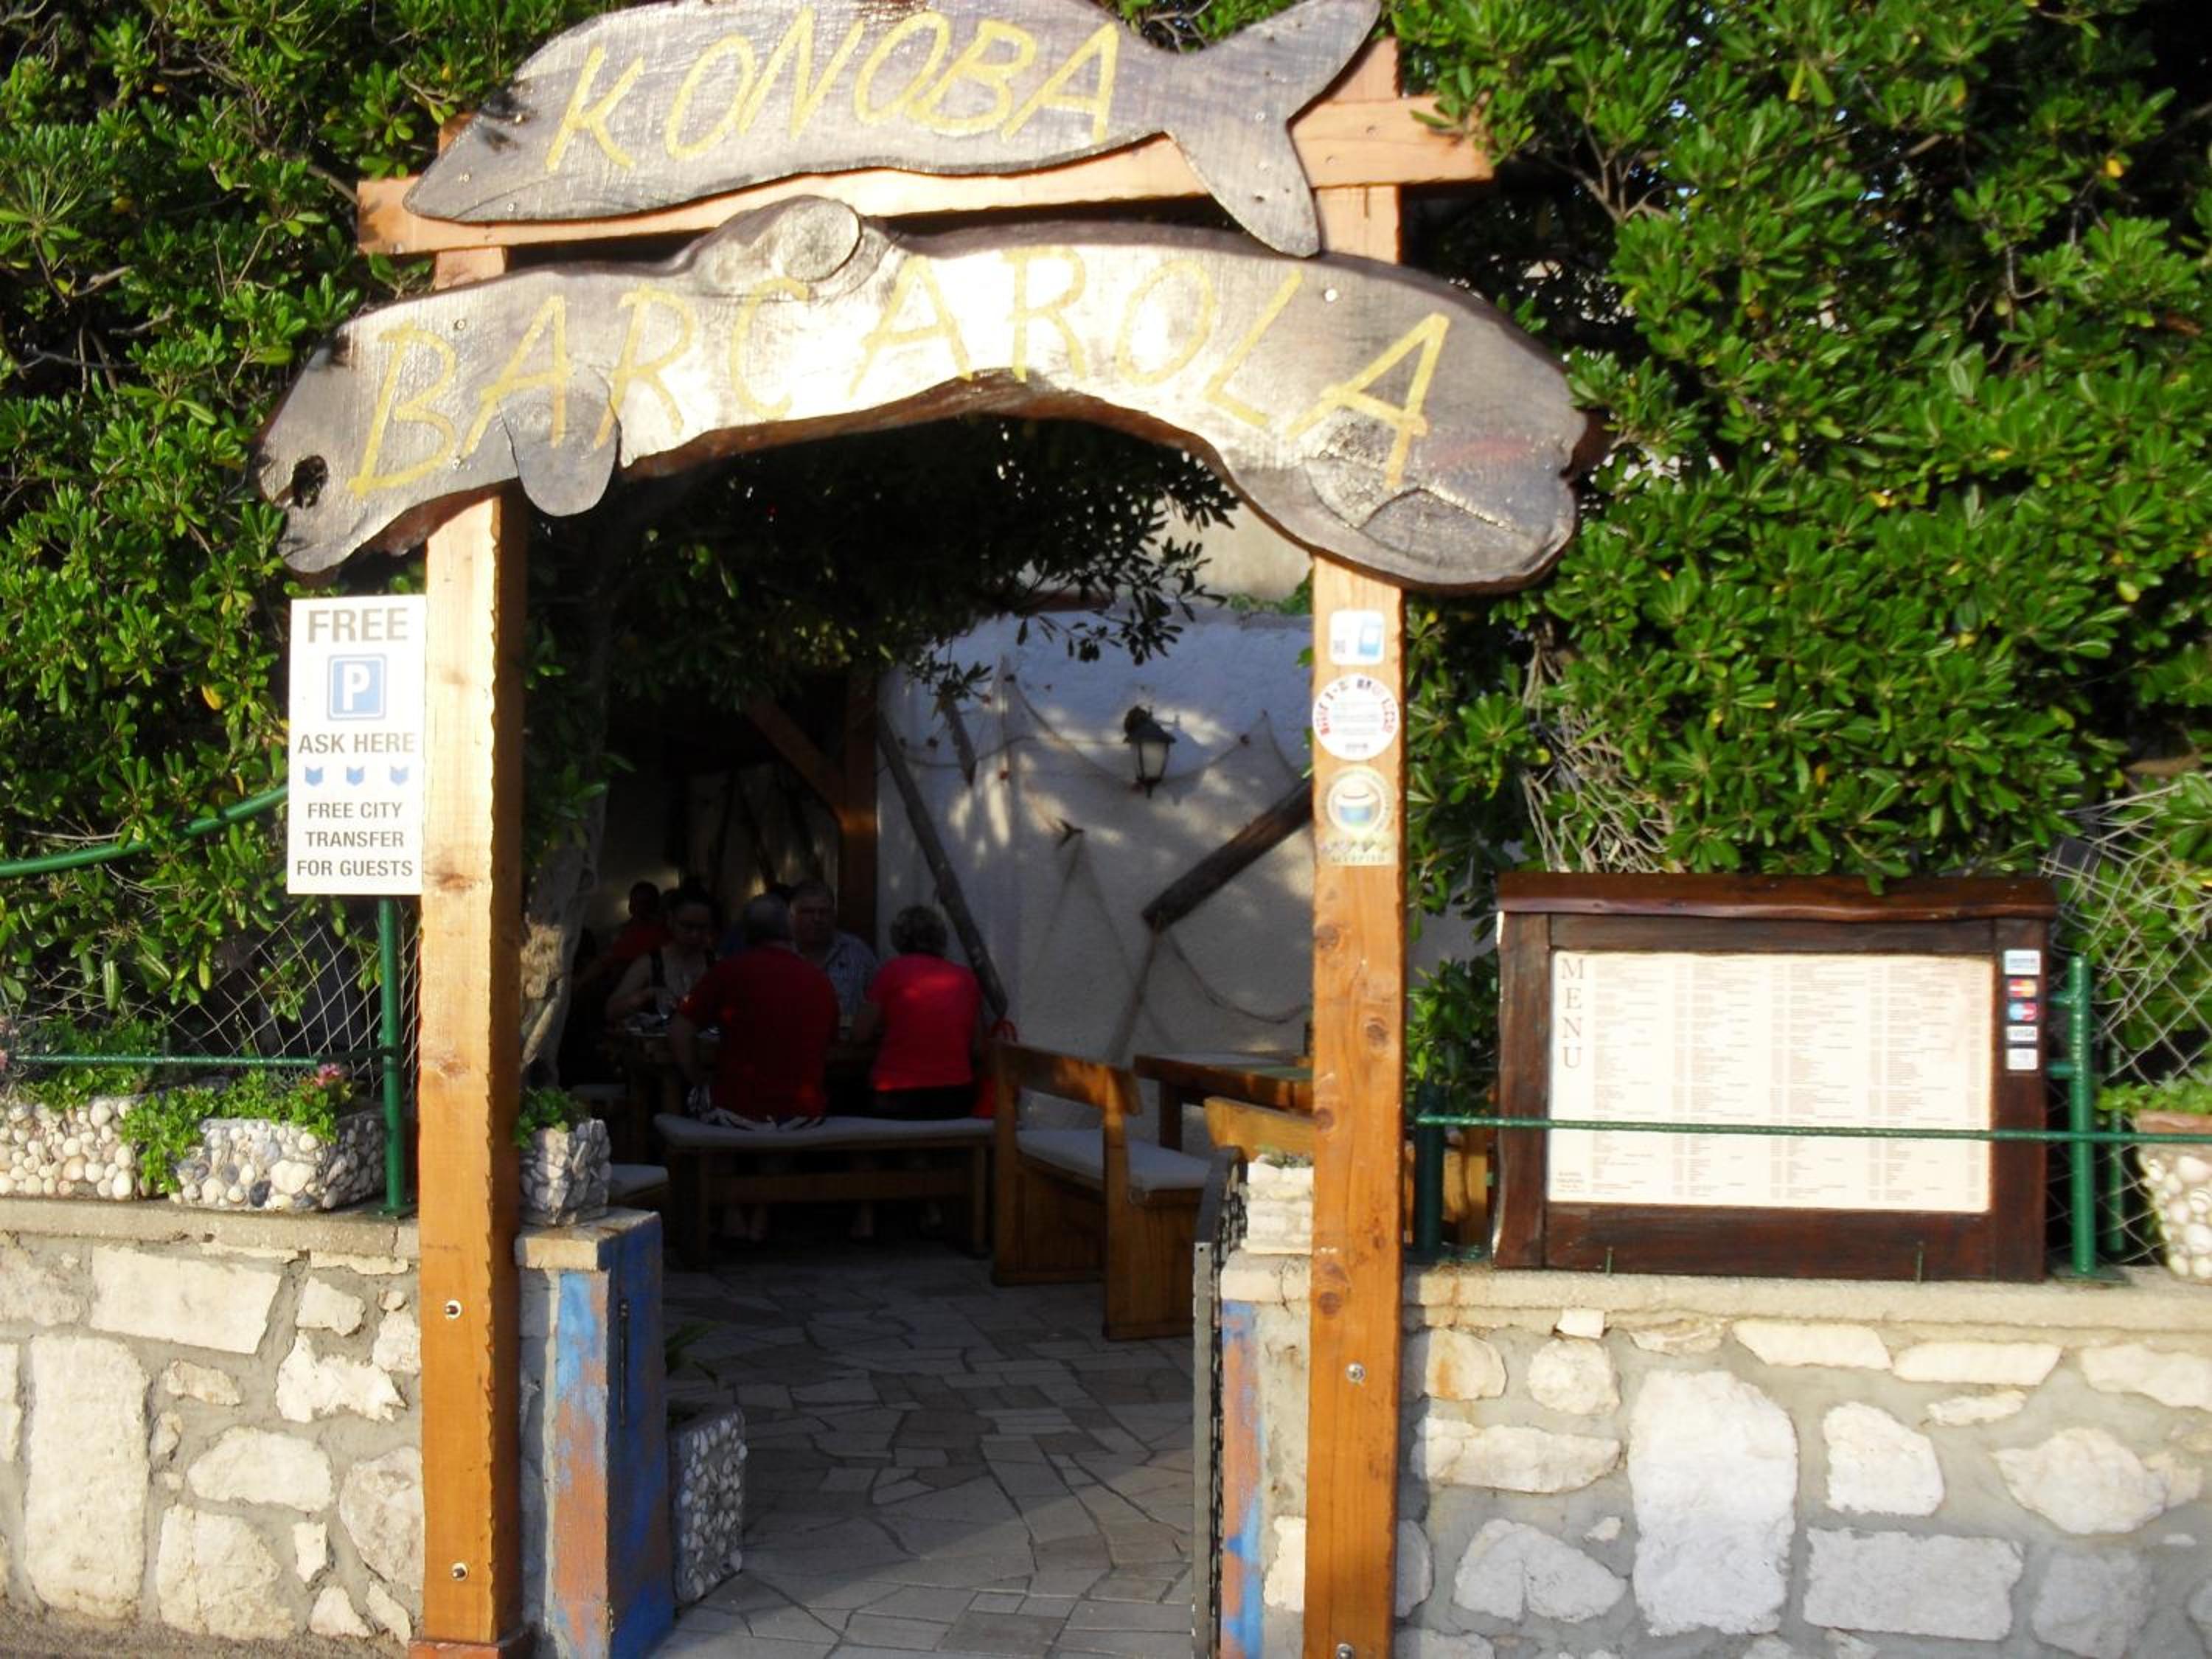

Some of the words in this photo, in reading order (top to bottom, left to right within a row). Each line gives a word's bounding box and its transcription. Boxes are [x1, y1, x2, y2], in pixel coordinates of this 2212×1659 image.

[545, 9, 1121, 173] KONOBA
[347, 245, 1450, 498] BARCAROLA
[307, 608, 409, 644] FREE
[342, 663, 371, 711] P
[297, 734, 346, 754] ASK
[352, 732, 415, 753] HERE
[307, 801, 354, 819] FREE
[361, 802, 403, 819] CITY
[305, 831, 405, 848] TRANSFER
[296, 860, 333, 877] FOR
[339, 860, 413, 877] GUESTS
[1561, 958, 1585, 1069] MENU
